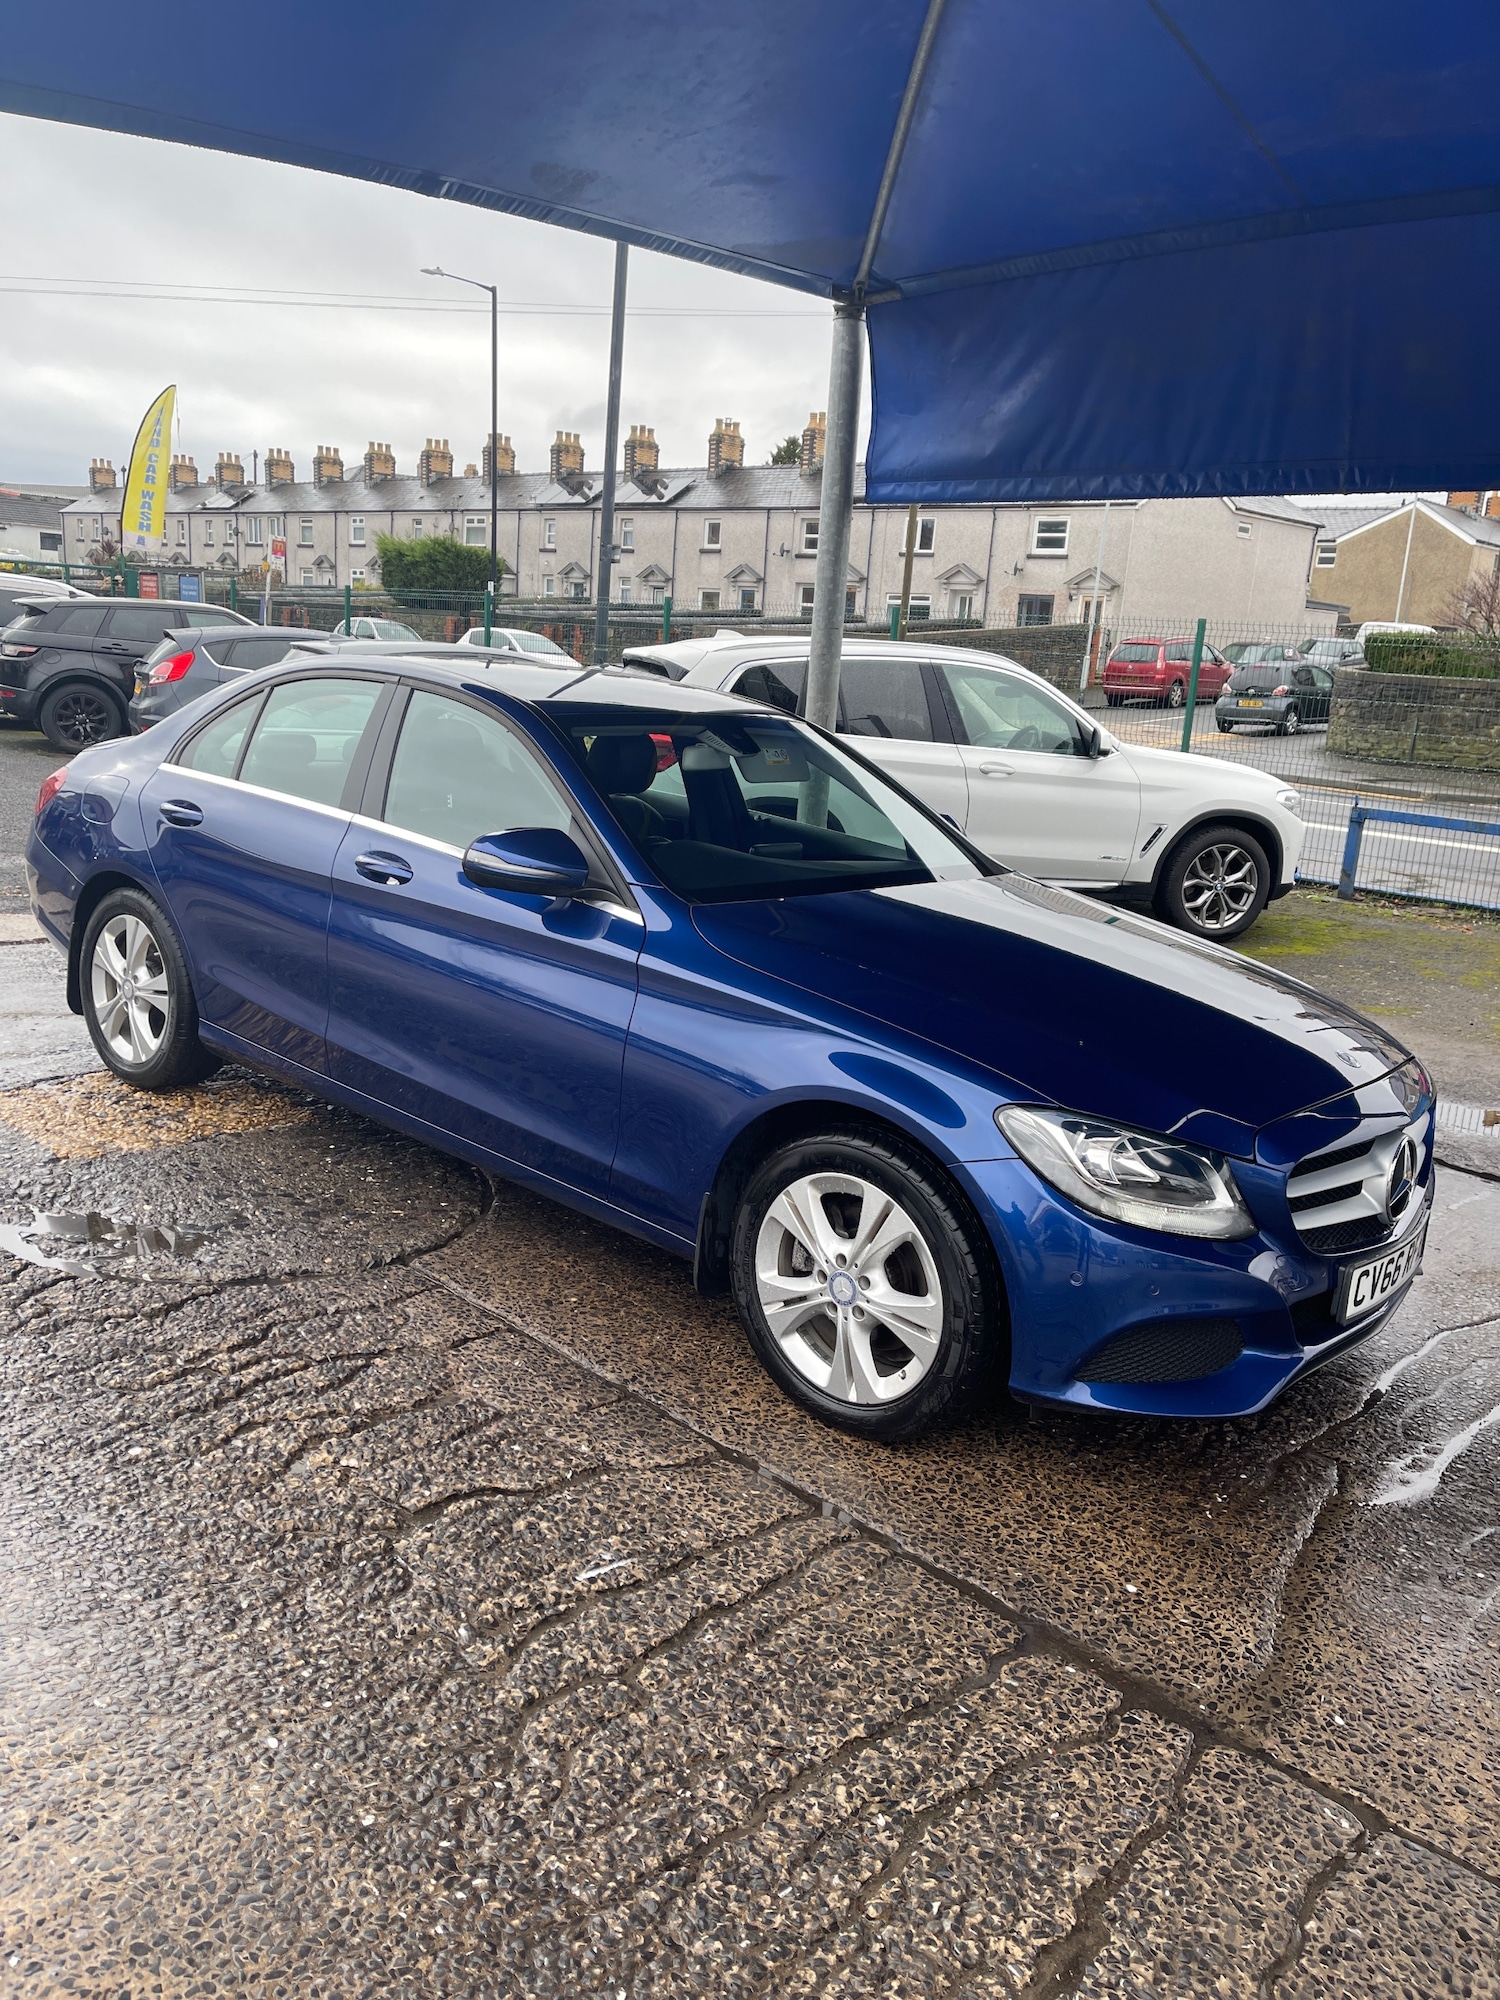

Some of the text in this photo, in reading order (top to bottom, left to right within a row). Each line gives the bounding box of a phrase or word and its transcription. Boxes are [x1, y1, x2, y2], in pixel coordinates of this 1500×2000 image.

[138, 407, 164, 532] HAND CAR WASH
[1353, 1250, 1405, 1307] CV66
